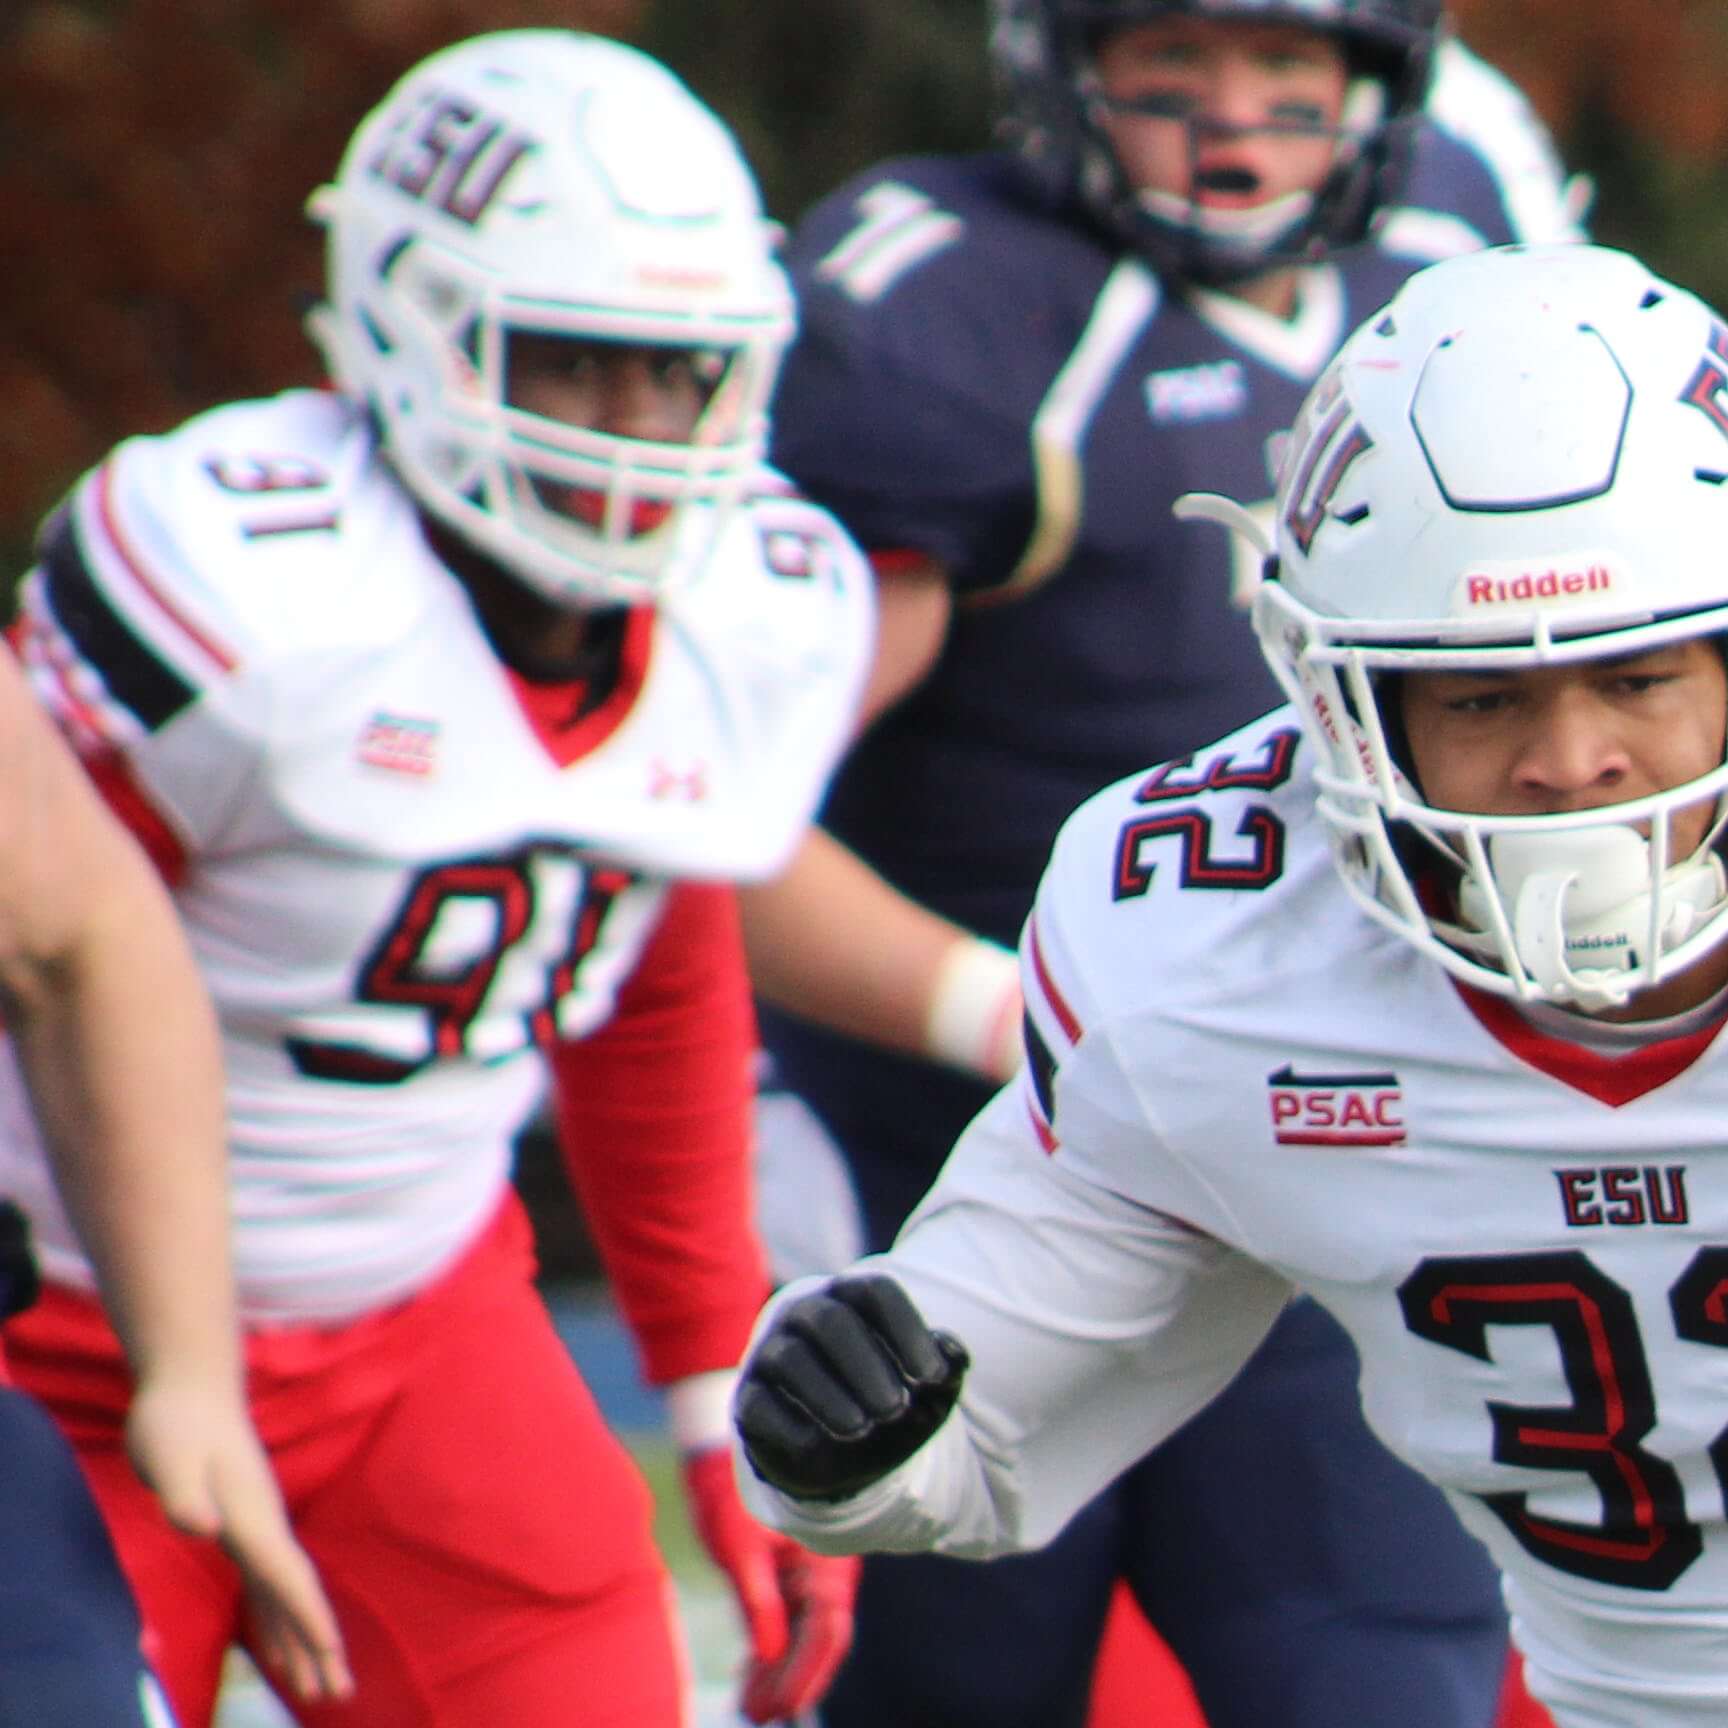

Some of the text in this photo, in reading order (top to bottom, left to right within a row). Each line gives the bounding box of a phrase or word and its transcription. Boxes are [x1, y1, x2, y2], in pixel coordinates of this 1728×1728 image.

[1467, 563, 1610, 605] Riddell
[1110, 728, 1302, 902] 32
[1270, 1089, 1404, 1127] PSAC
[1556, 1167, 1687, 1226] ESU
